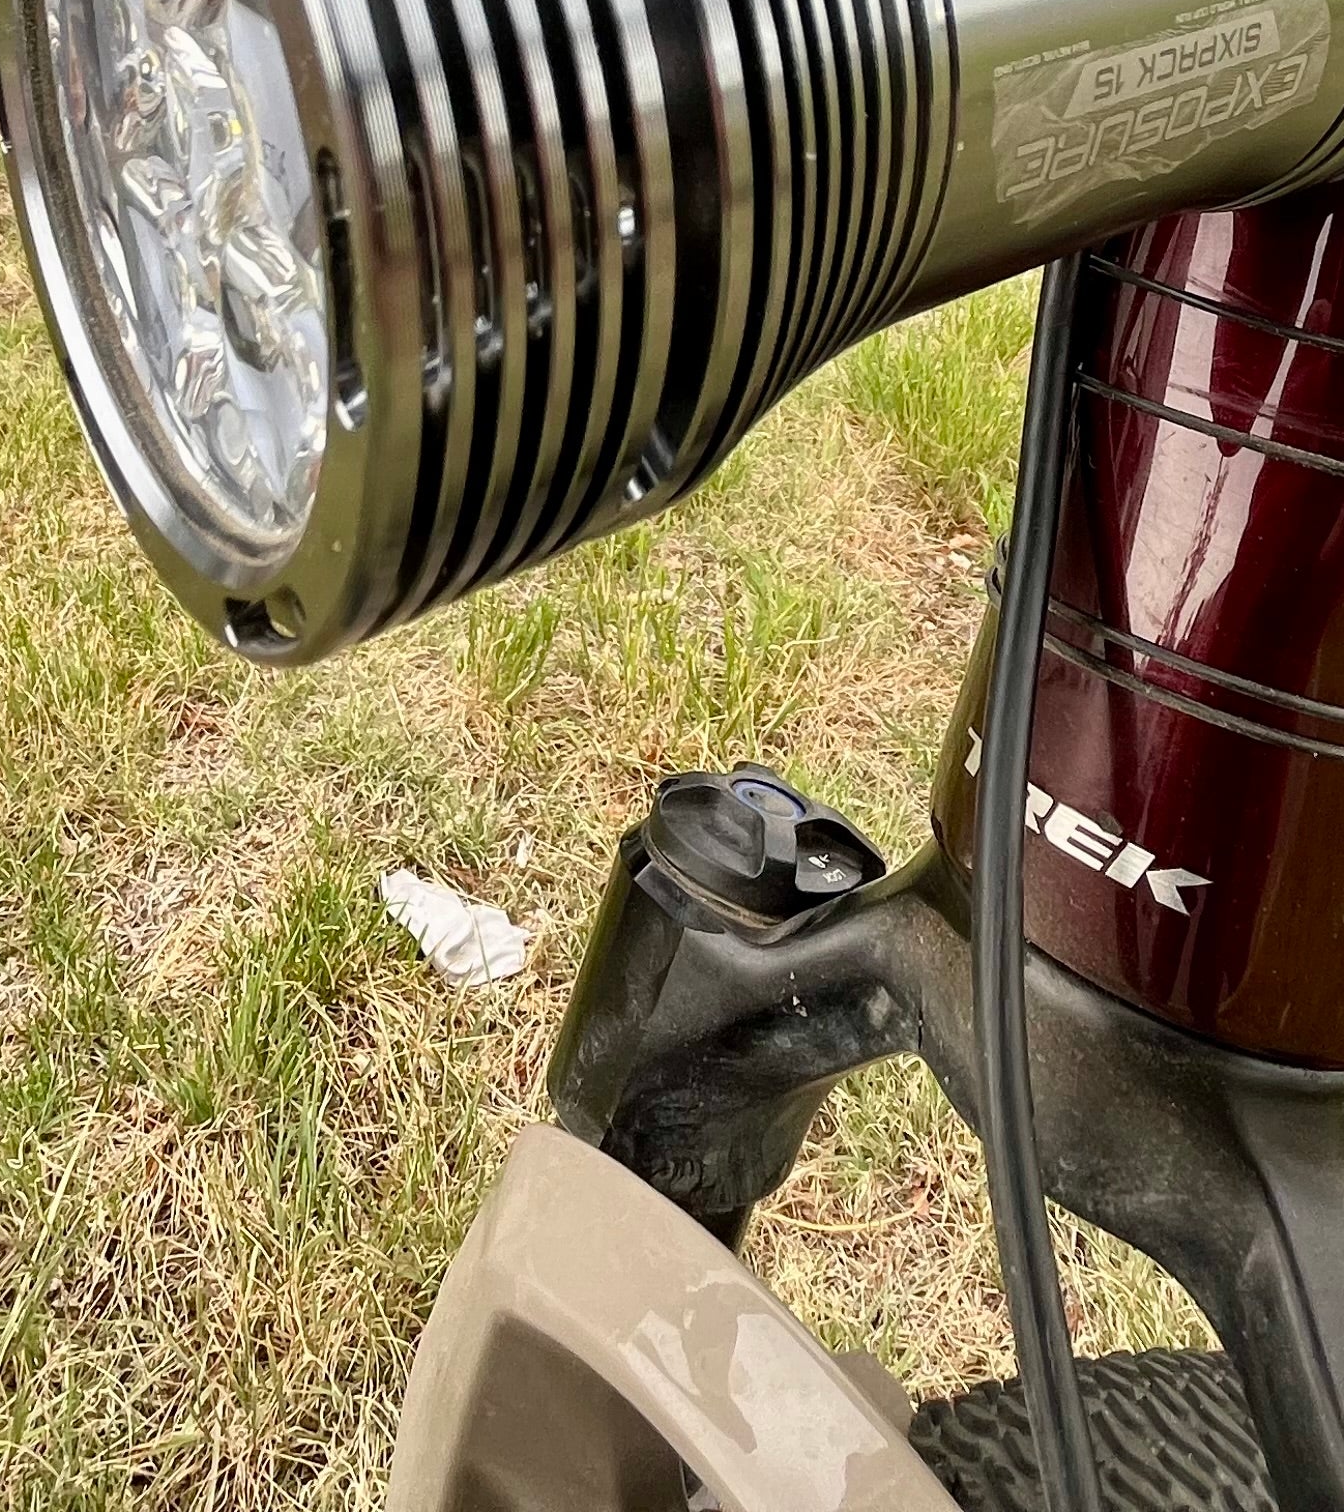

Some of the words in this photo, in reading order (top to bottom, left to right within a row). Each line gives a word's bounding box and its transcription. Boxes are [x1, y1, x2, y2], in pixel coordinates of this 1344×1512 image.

[1093, 62, 1126, 102] 15
[1137, 21, 1263, 88] SIXPACK
[1006, 53, 1310, 198] EXPOSURE
